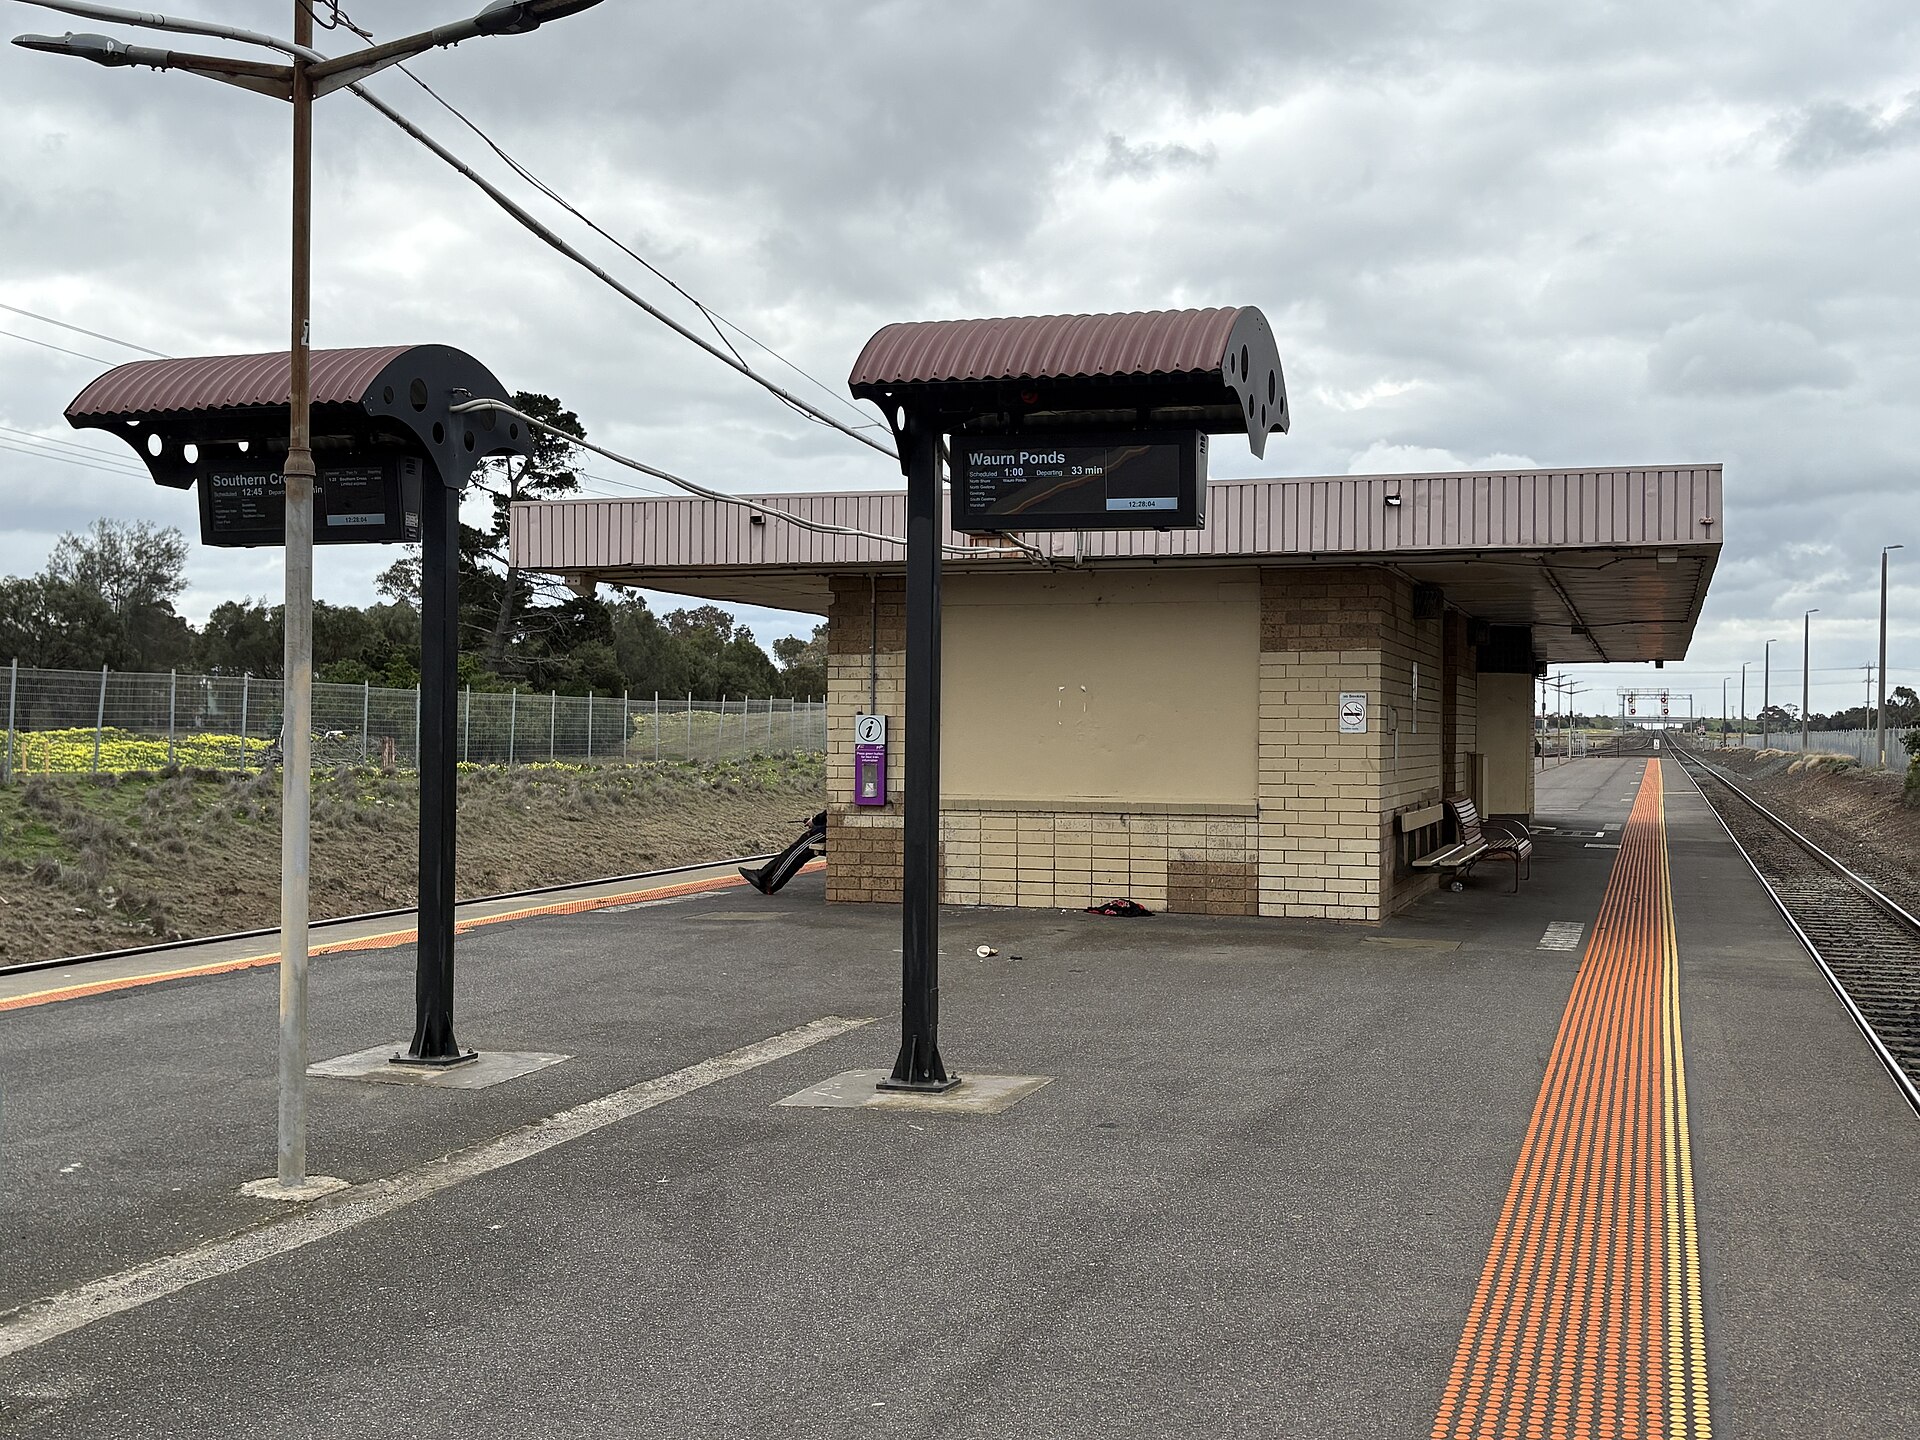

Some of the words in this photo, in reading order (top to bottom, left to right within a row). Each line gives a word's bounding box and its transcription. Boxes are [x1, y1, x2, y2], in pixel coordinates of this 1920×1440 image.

[969, 453, 1015, 465] Waurn
[1019, 451, 1065, 464] Ponds
[1004, 468, 1023, 476] 1:00
[1071, 466, 1082, 475] 33
[1085, 466, 1103, 474] min
[213, 474, 266, 486] Southern
[1128, 500, 1156, 508] 12:28:04
